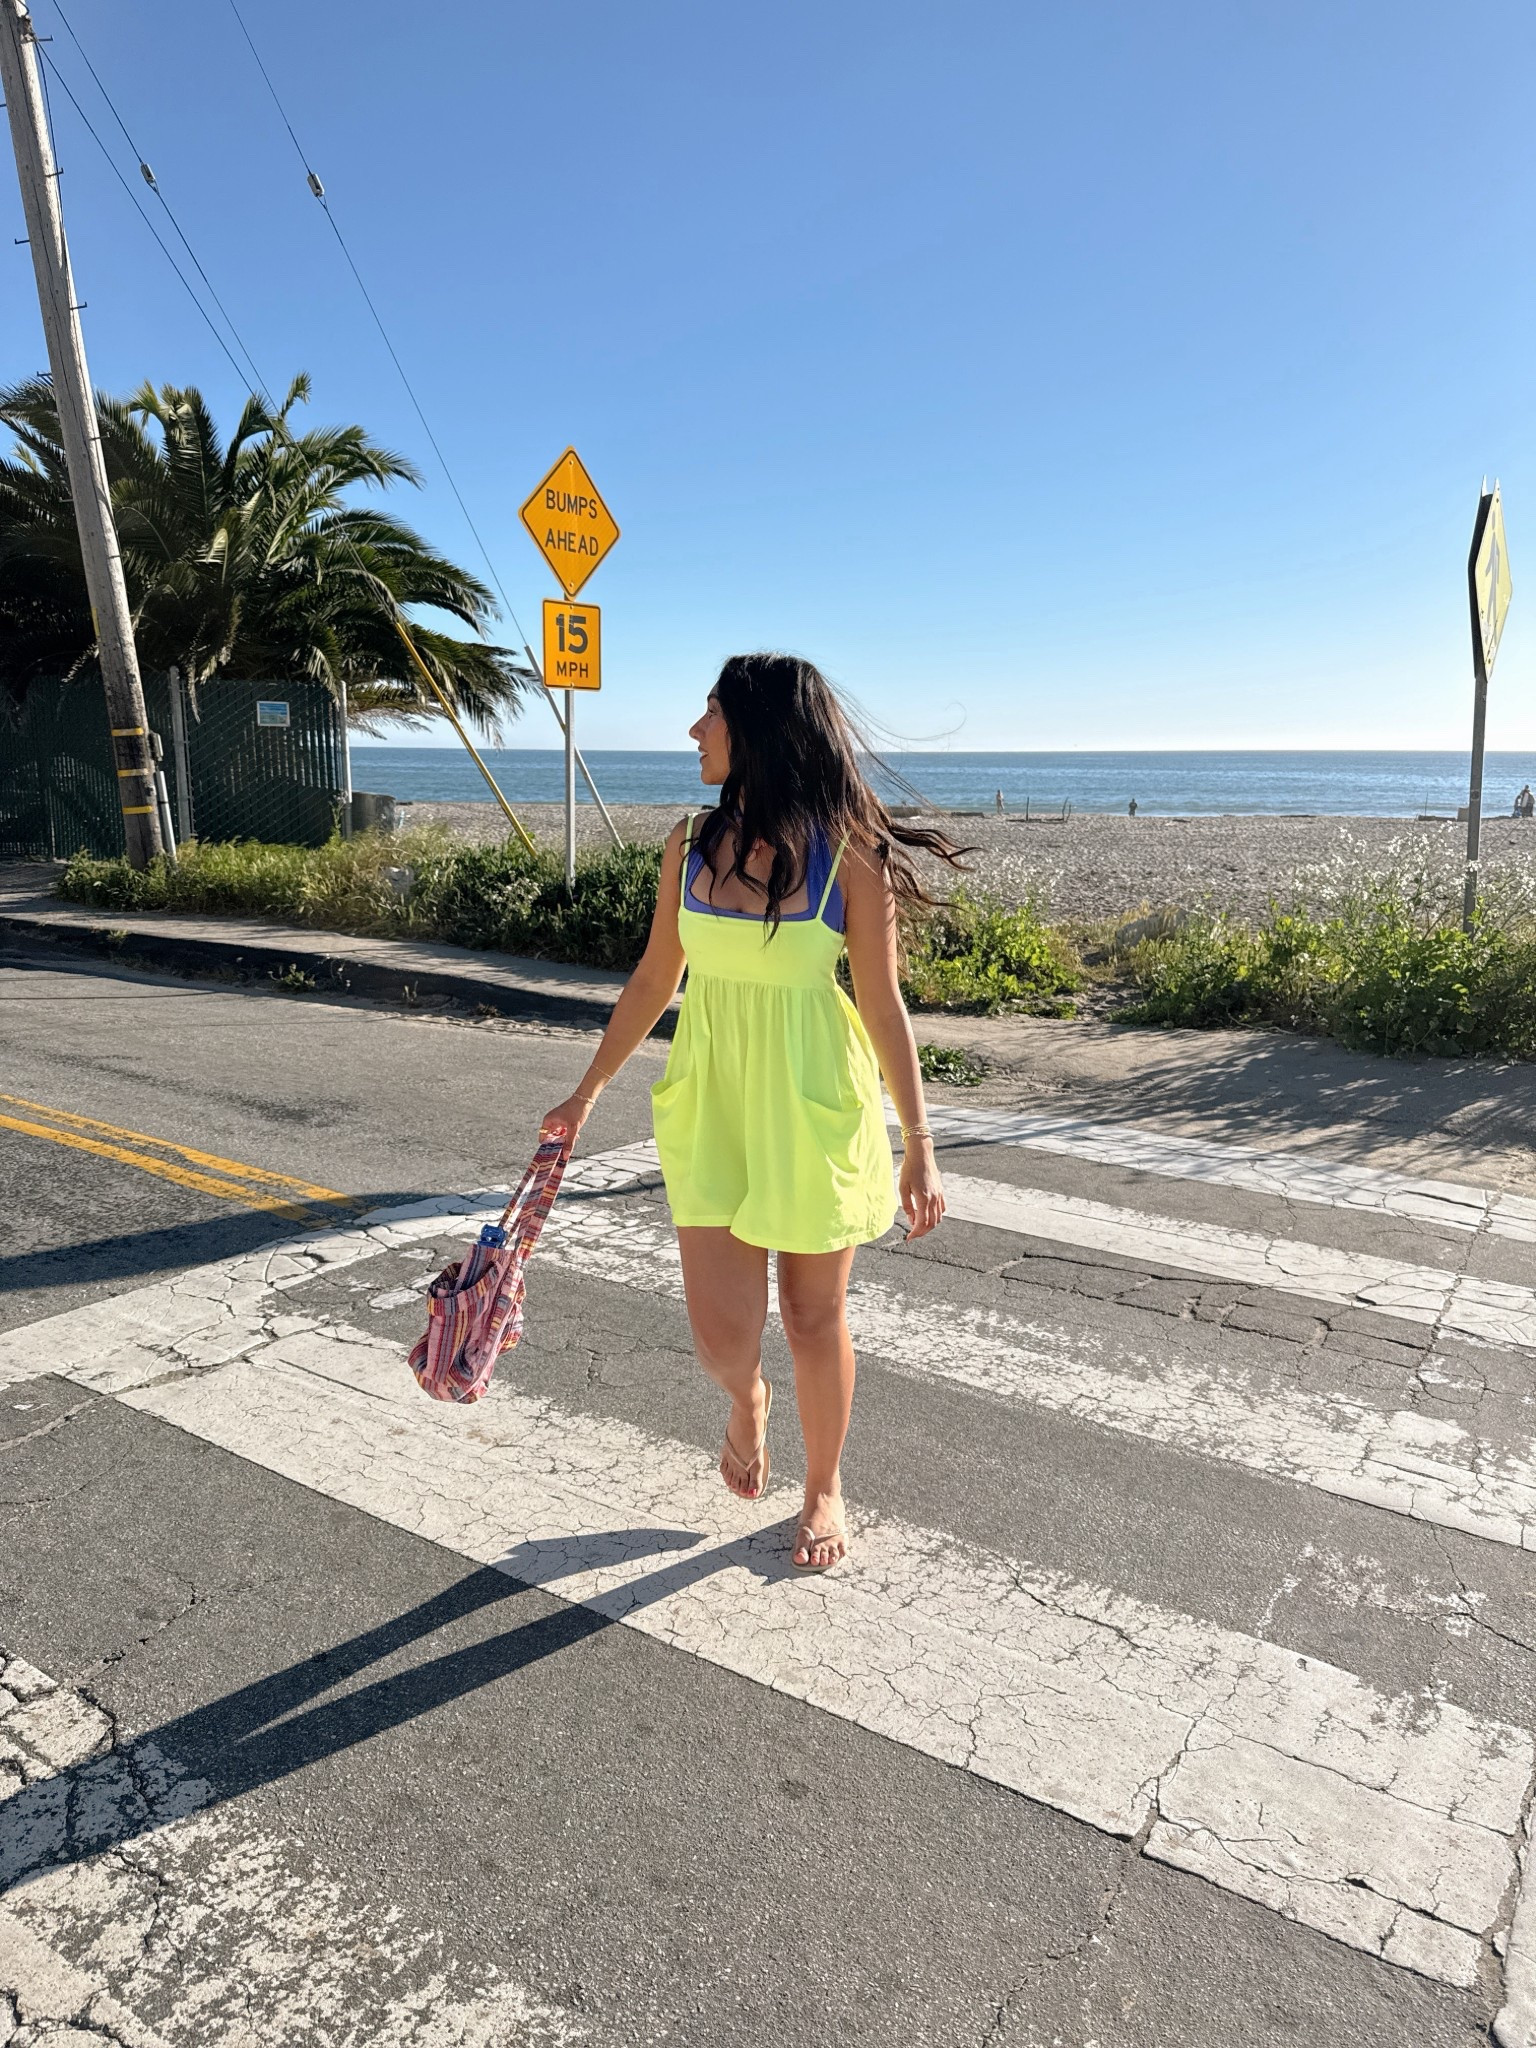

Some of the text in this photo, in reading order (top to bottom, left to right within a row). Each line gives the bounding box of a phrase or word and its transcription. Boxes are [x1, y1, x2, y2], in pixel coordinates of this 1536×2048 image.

[546, 488, 598, 519] BUMPS
[544, 528, 599, 557] AHEAD
[556, 613, 589, 655] 15
[556, 661, 589, 678] MPH
